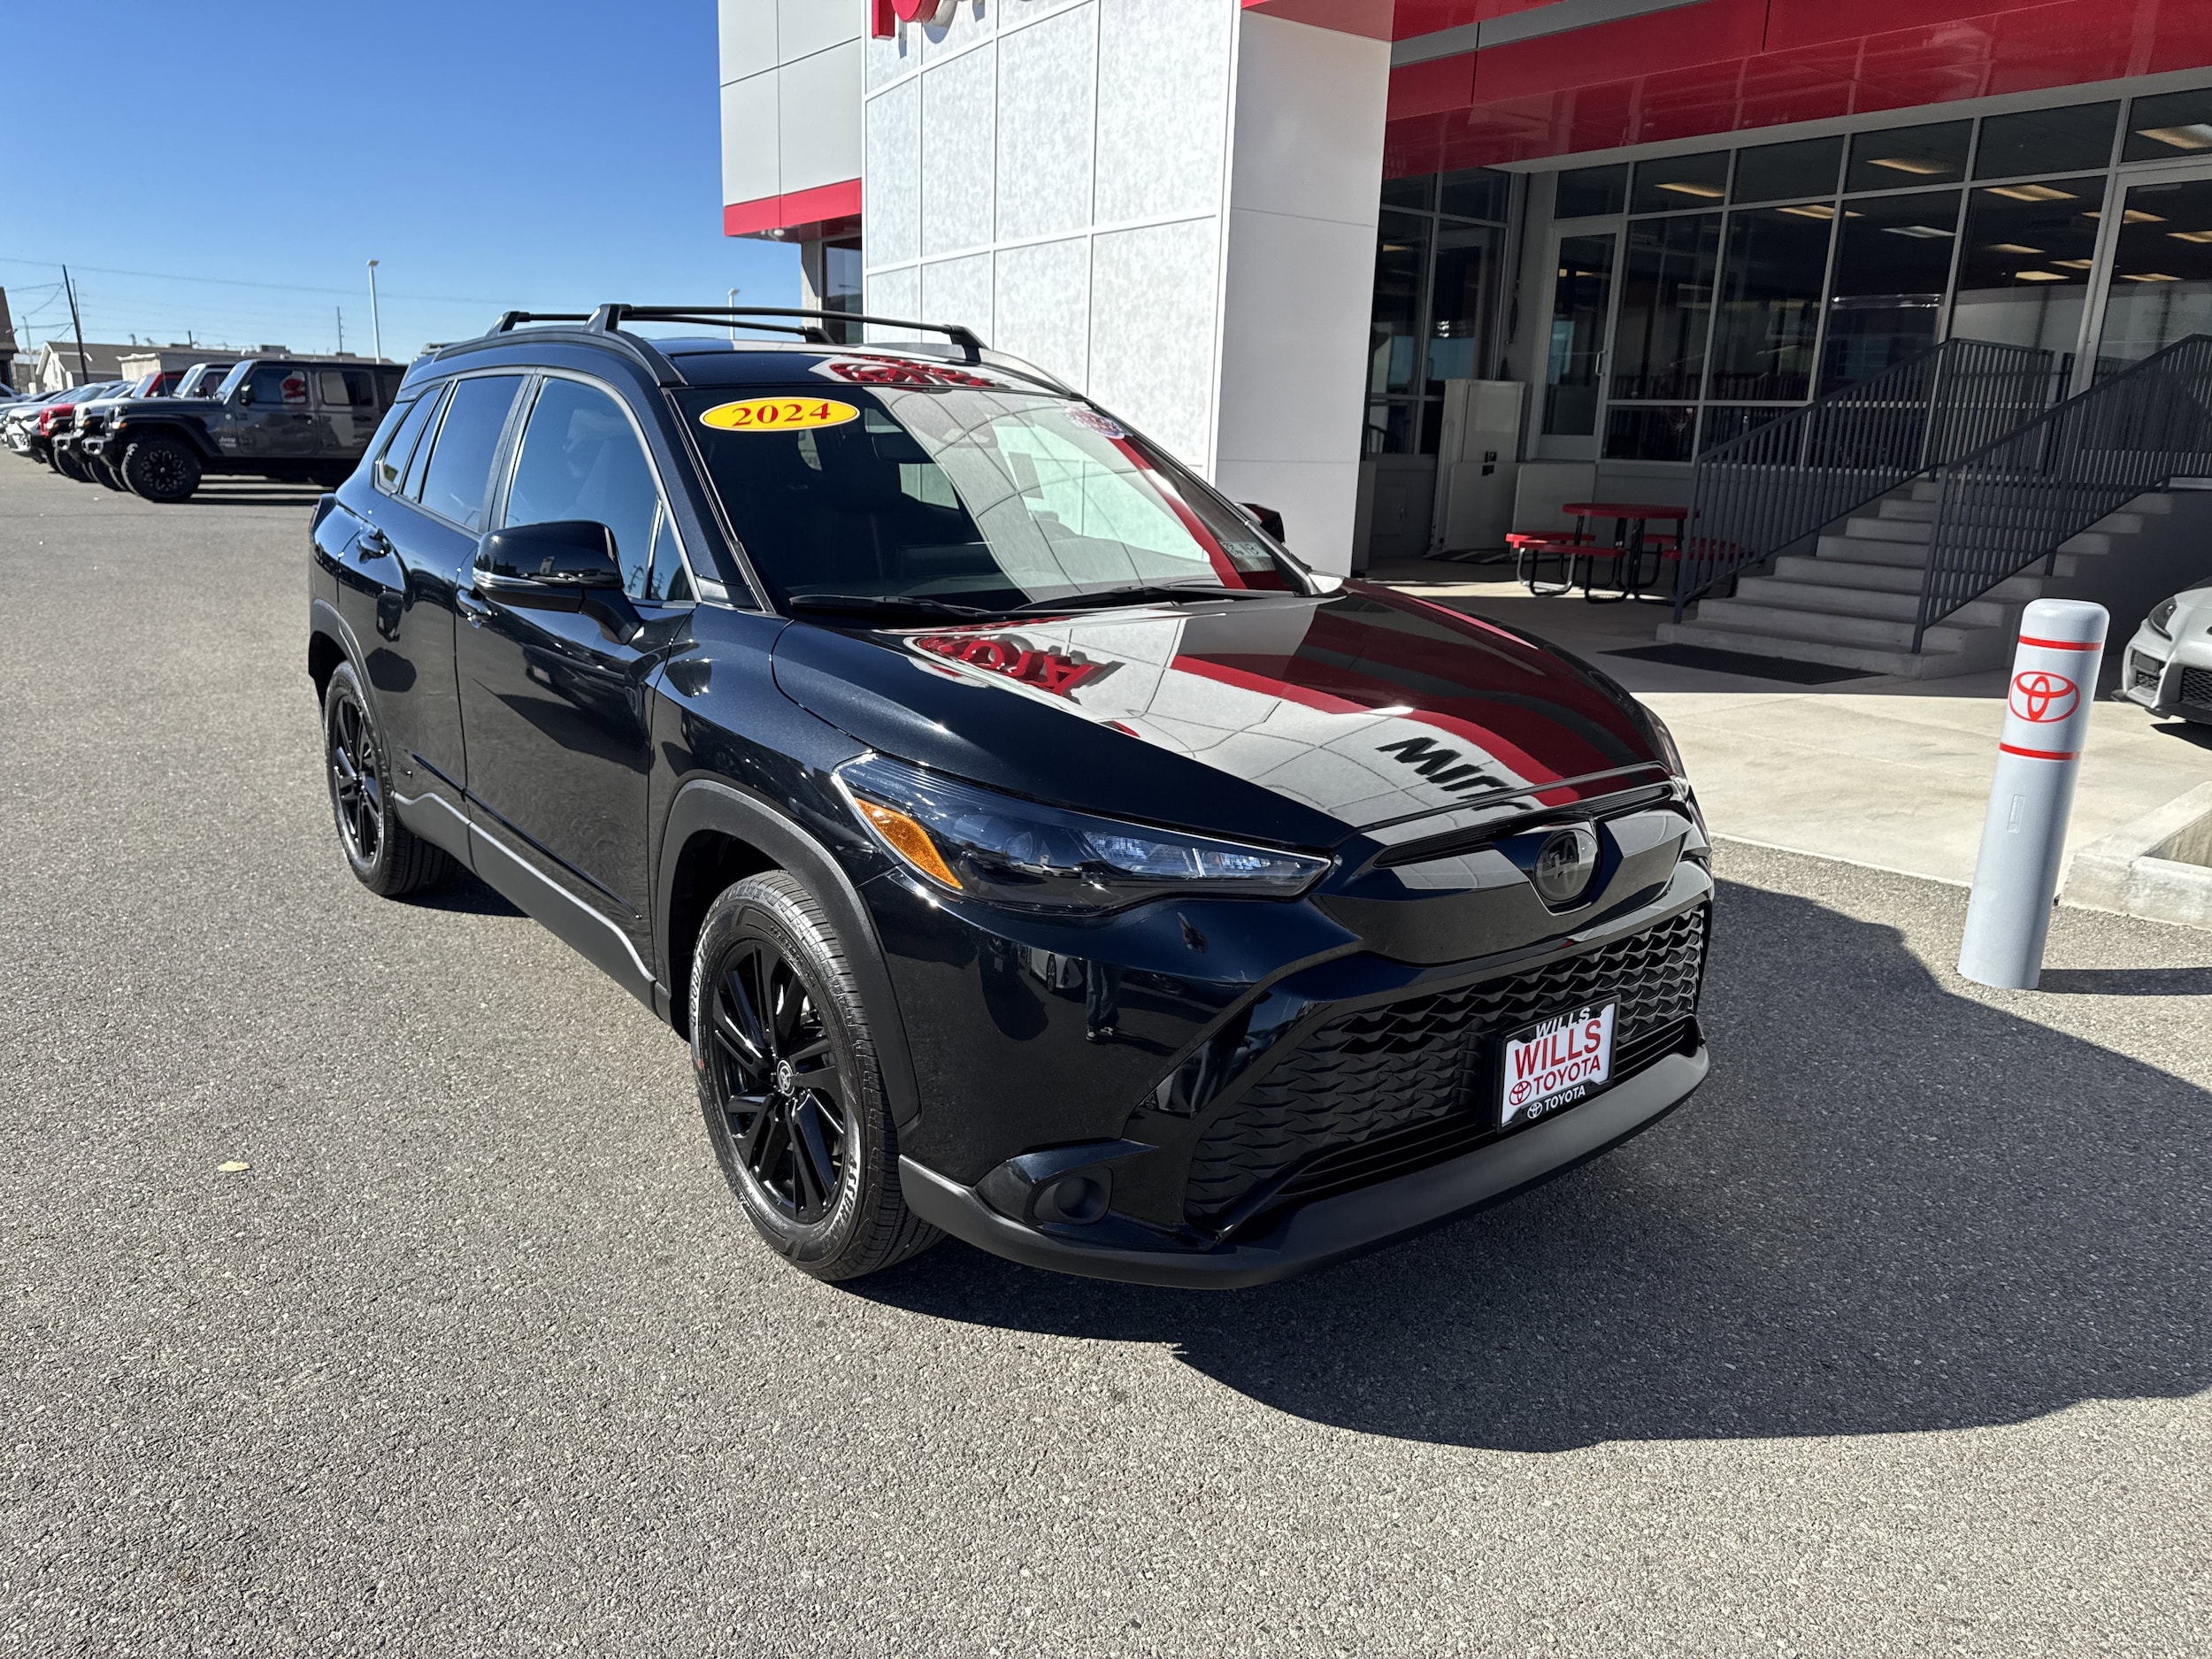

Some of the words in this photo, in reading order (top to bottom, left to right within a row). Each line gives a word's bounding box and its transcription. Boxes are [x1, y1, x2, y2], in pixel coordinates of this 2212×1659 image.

[732, 402, 831, 426] 2024
[1535, 1007, 1591, 1039] WILLS
[1514, 1019, 1601, 1080] WILLS
[1533, 1054, 1601, 1095] TOYOTA
[1544, 1085, 1586, 1111] TOYOTA
